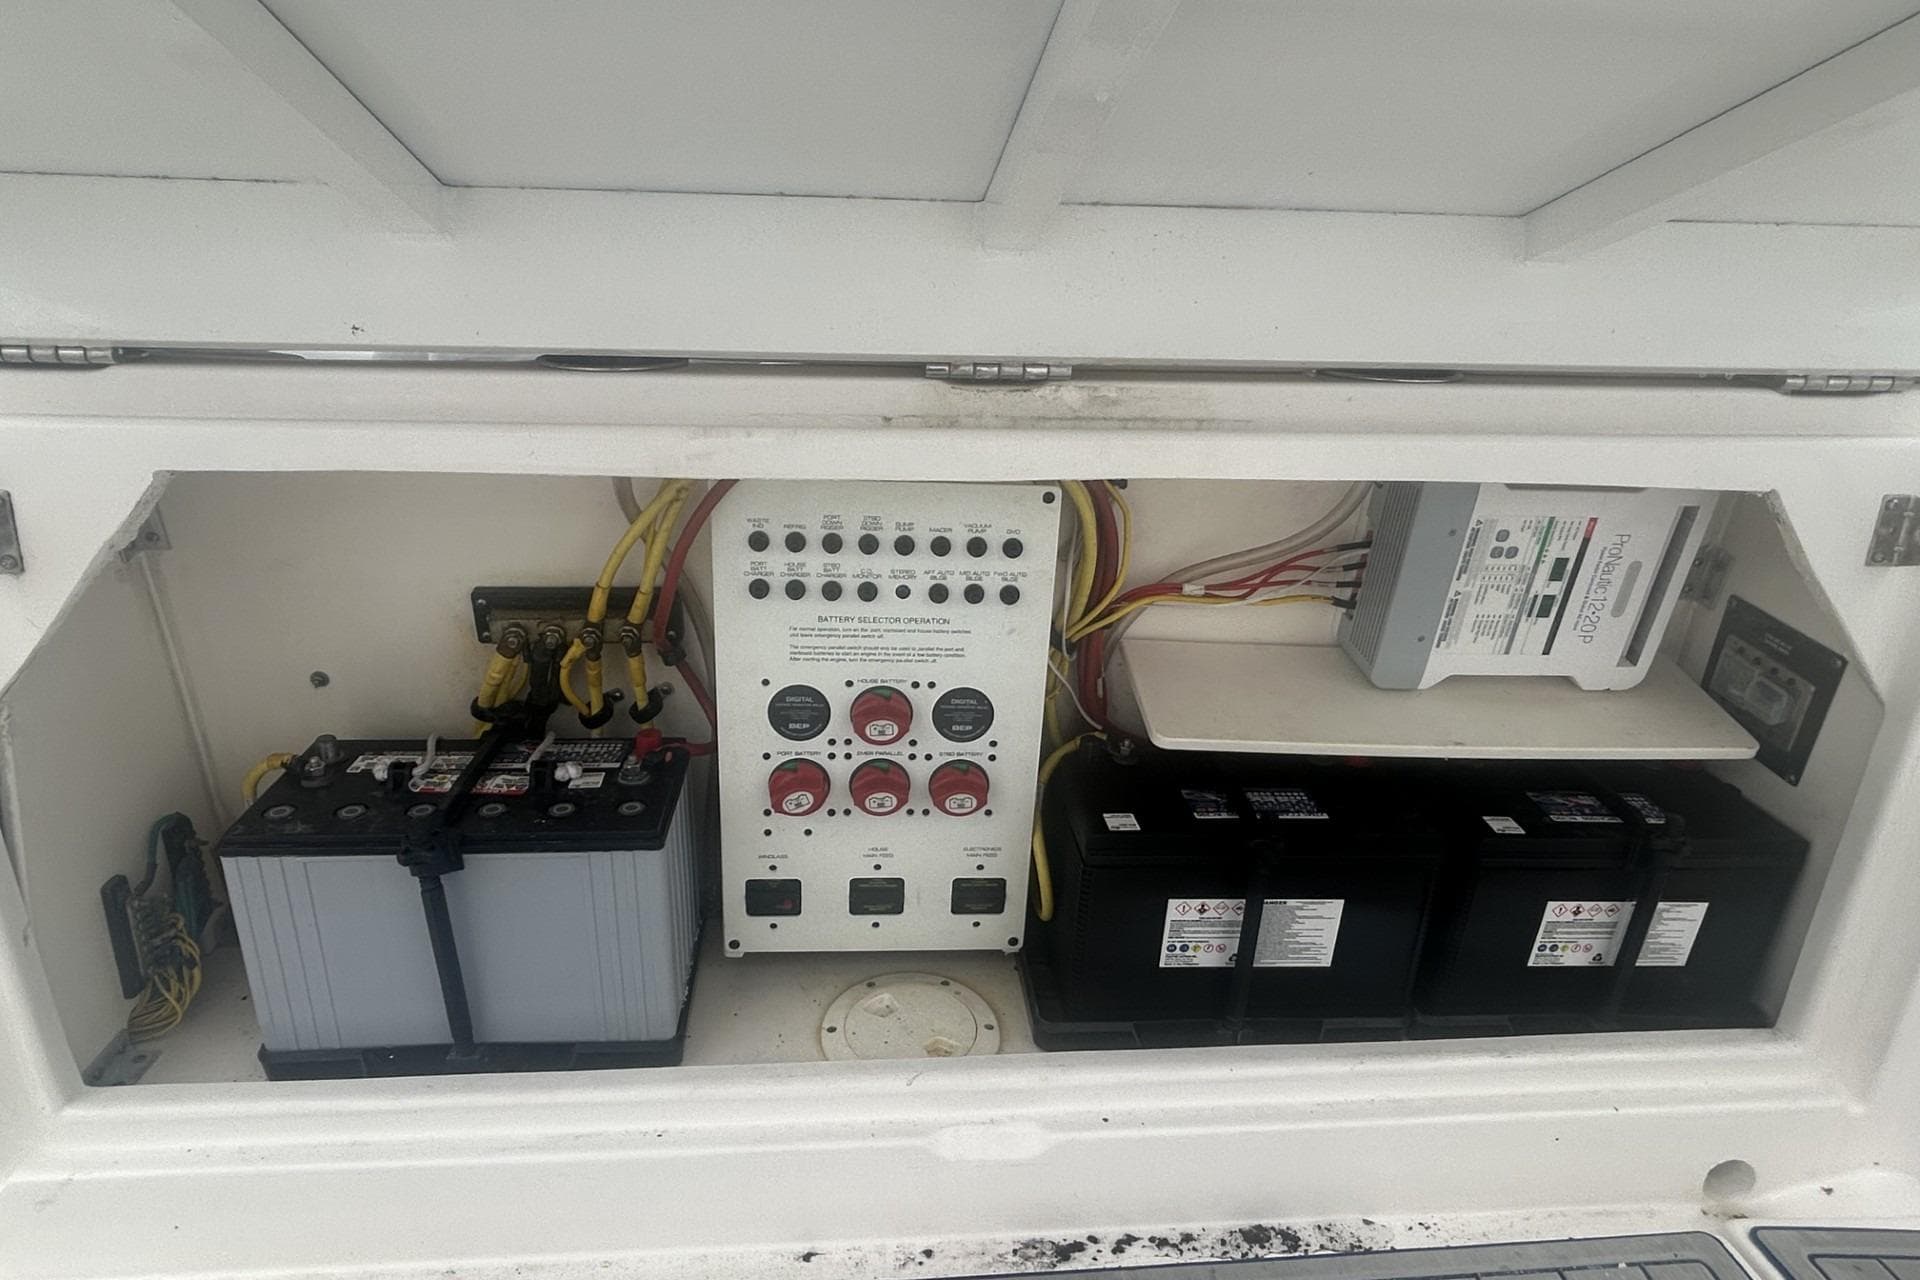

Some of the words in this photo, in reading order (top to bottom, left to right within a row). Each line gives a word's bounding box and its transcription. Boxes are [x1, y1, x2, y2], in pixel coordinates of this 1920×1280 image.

[1594, 534, 1631, 594] ProNautic
[817, 615, 856, 624] BATTERY
[857, 616, 901, 624] SELECTOR
[903, 617, 950, 625] OPERATION
